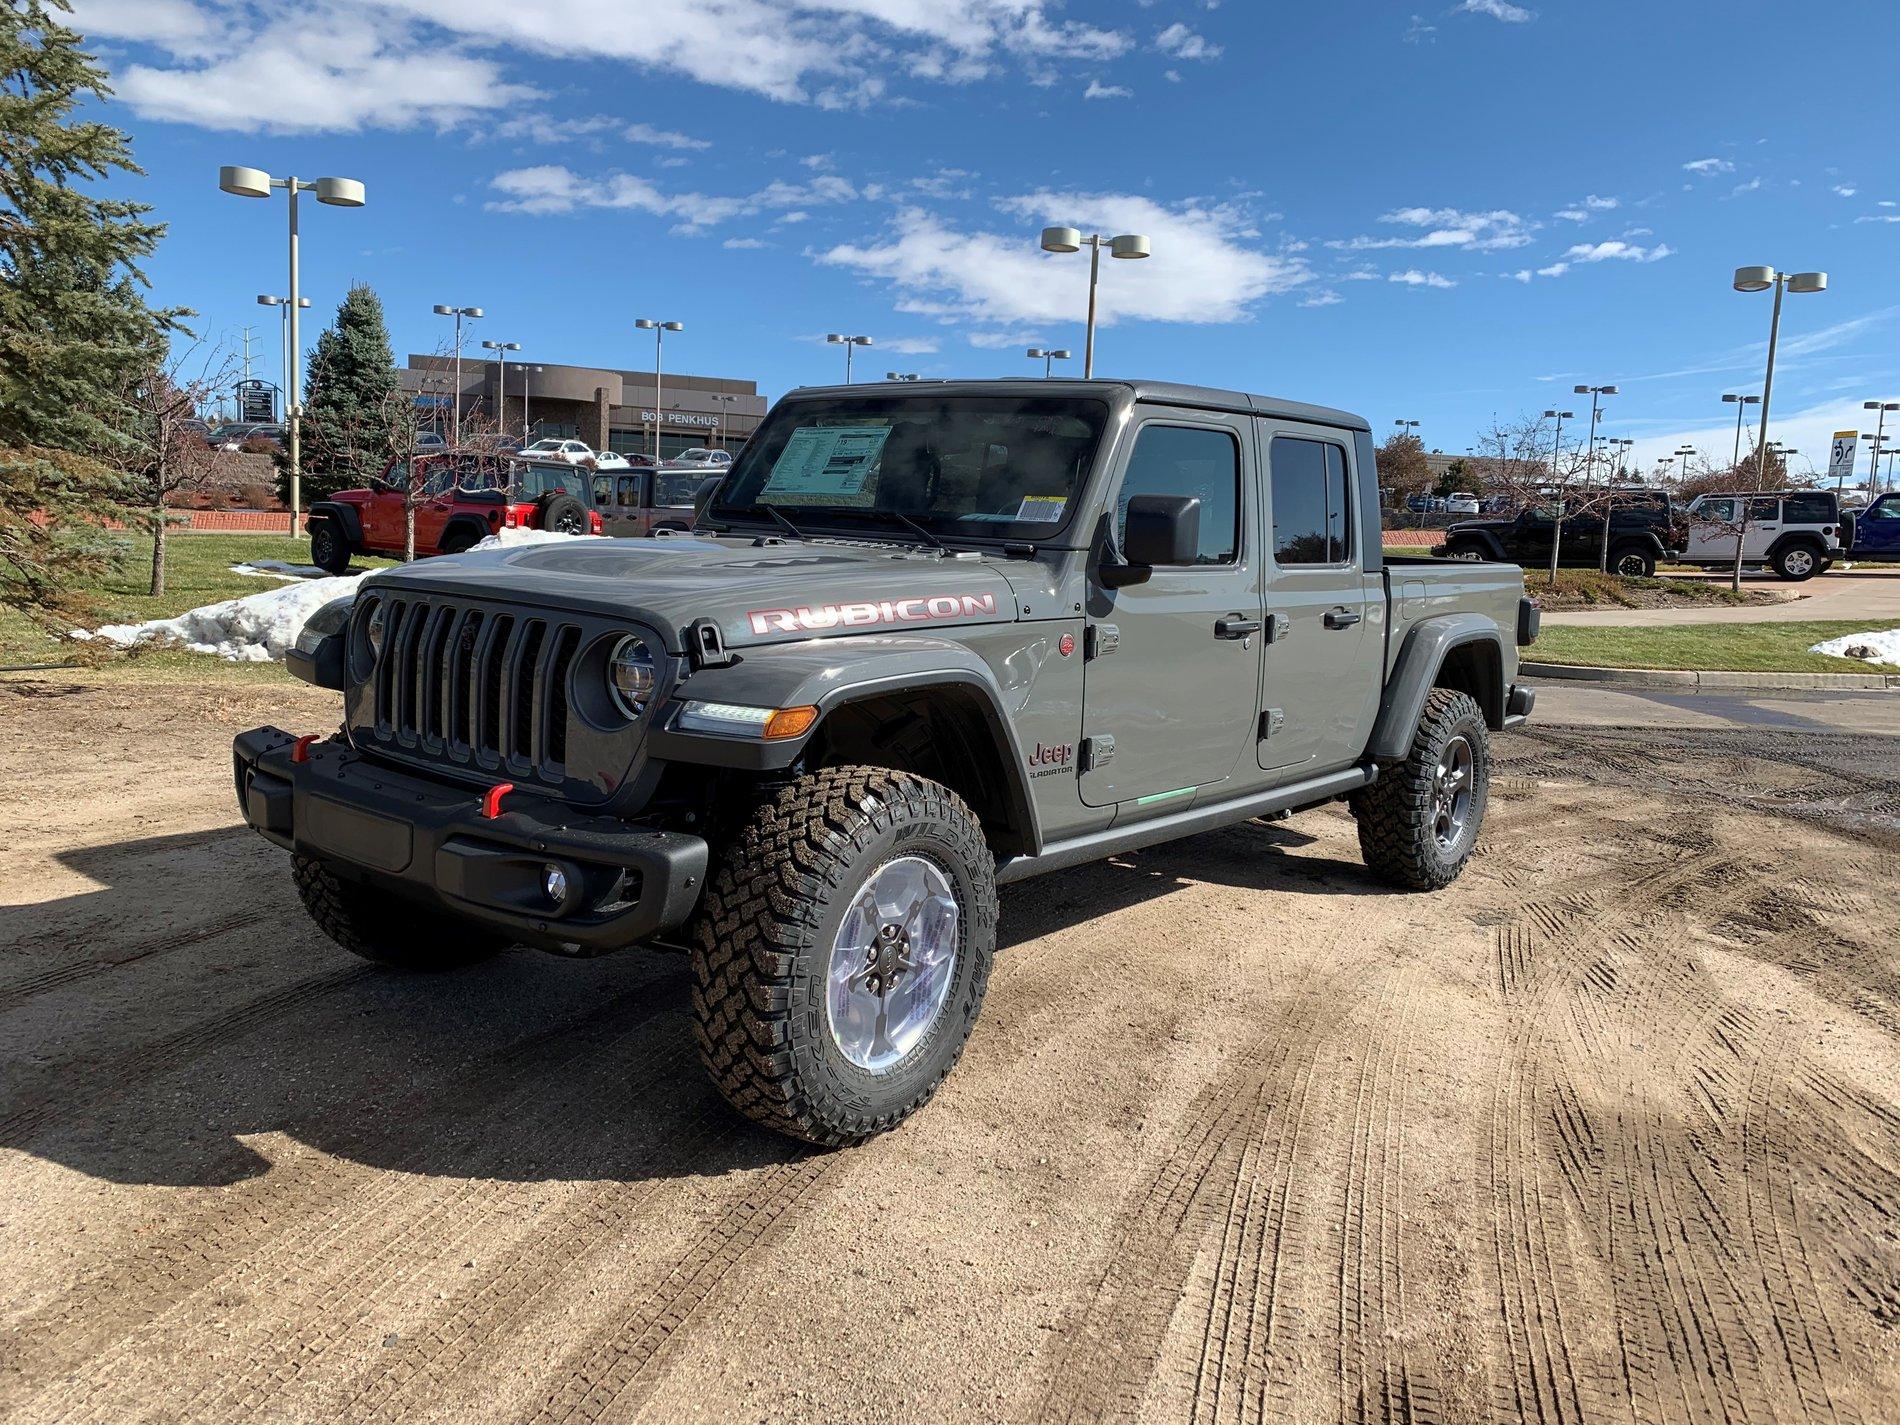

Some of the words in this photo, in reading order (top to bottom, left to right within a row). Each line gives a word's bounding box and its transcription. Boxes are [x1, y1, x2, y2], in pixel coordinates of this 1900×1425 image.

[641, 411, 664, 422] BOB
[668, 413, 719, 426] PENKHUS
[748, 593, 997, 635] RUBICON
[1029, 742, 1072, 766] Jeep
[893, 821, 989, 928] WILDPEAK
